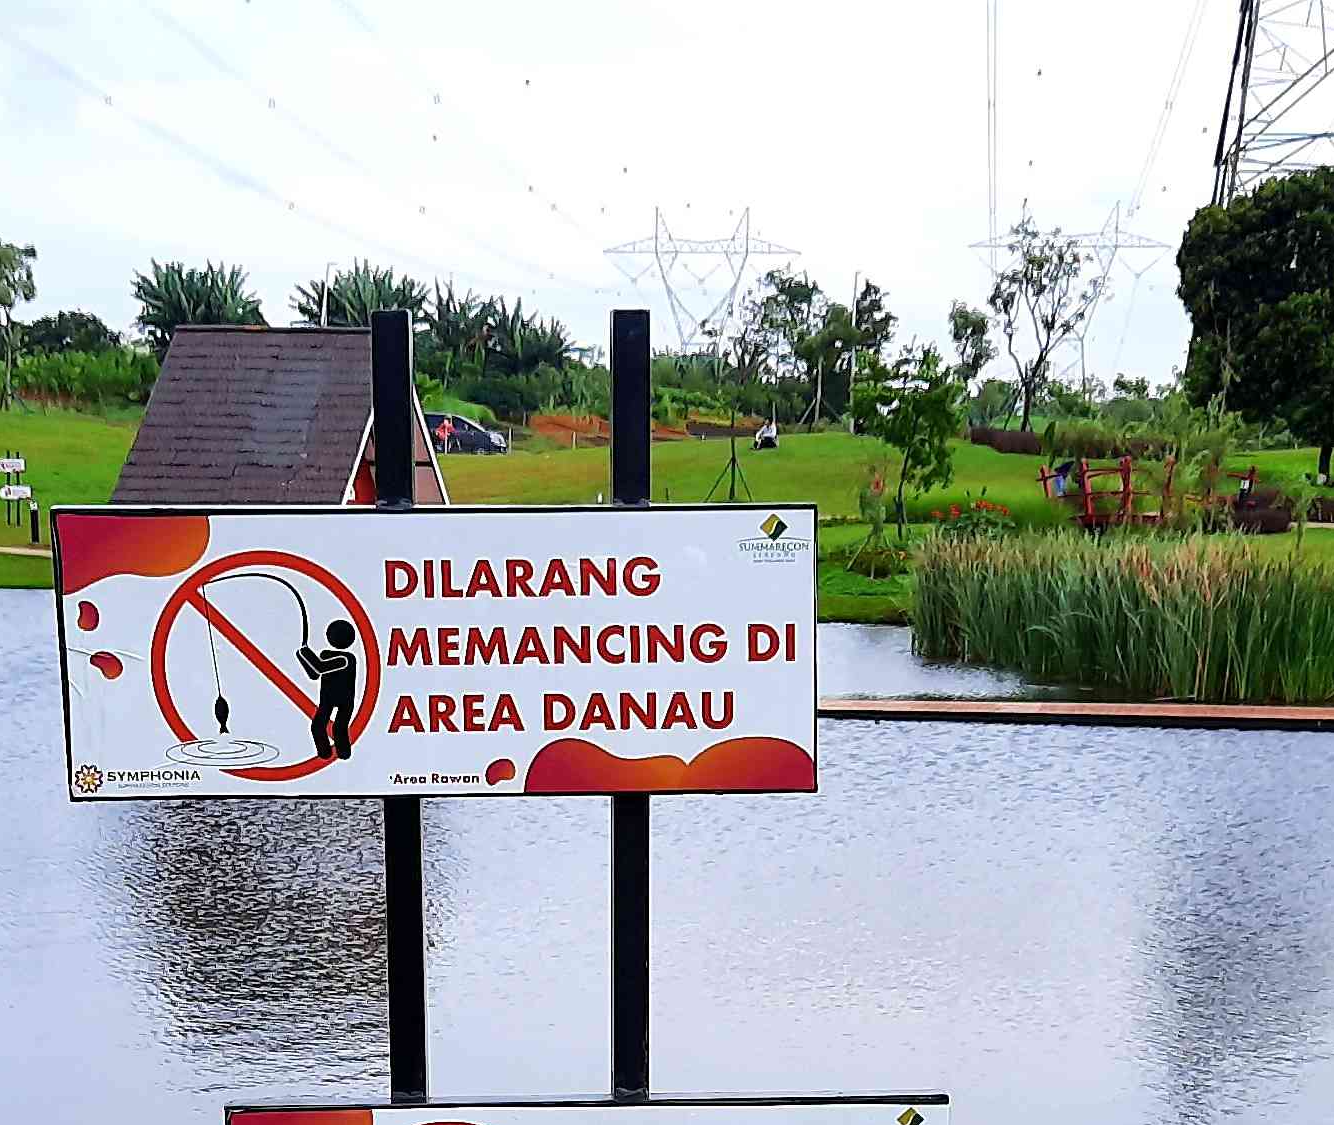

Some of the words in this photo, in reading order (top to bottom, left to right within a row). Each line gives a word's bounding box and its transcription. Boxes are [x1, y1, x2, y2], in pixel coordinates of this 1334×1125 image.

[384, 556, 662, 600] DILARANG
[387, 622, 729, 667] MEMANCING
[747, 622, 797, 663] DI
[388, 694, 525, 734] AREA
[542, 691, 734, 732] DANAU
[106, 770, 201, 782] SYMPHONIA
